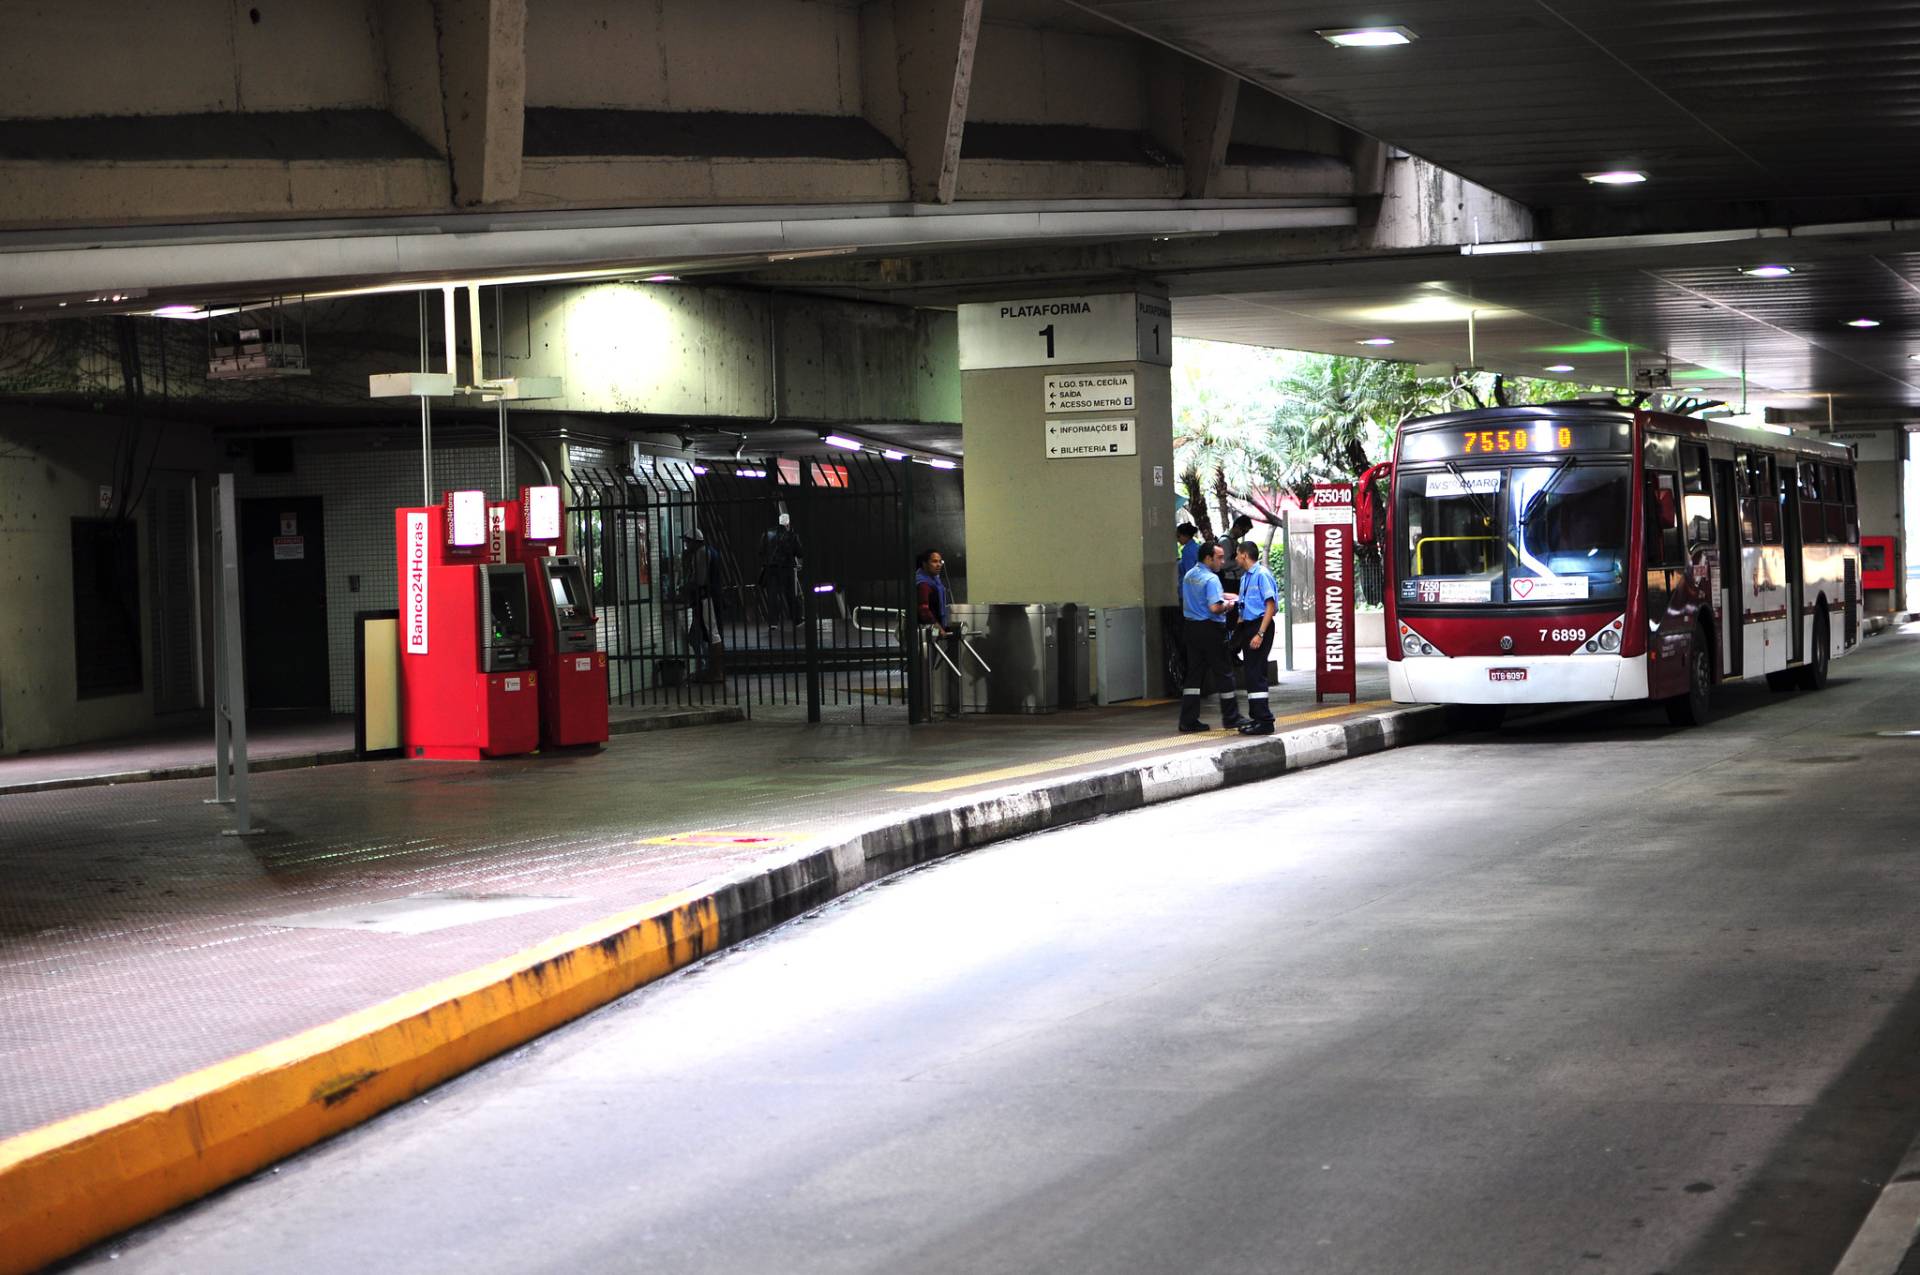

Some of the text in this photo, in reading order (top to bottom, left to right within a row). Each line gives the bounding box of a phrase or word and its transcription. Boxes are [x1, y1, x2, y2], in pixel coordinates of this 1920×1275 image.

[1001, 302, 1091, 318] PLATAFORMA
[1039, 324, 1055, 359] 1
[1152, 324, 1160, 355] 1
[1079, 380, 1096, 388] STA.
[1096, 378, 1128, 386] CECÍLIA
[1060, 390, 1081, 398] SAÍDA
[1060, 398, 1122, 408] ACESSO METRÔ
[1060, 424, 1118, 434] INFORMAÇÕES
[1060, 445, 1106, 454] BILHETERIA
[1313, 488, 1352, 503] 7550-10
[447, 492, 455, 544] Banco24Horas
[1325, 528, 1344, 582] AMARO
[411, 521, 423, 646] Banco24Horas
[1420, 582, 1439, 591] 7550
[1423, 592, 1435, 602] 10
[1538, 628, 1586, 642] 7 6899
